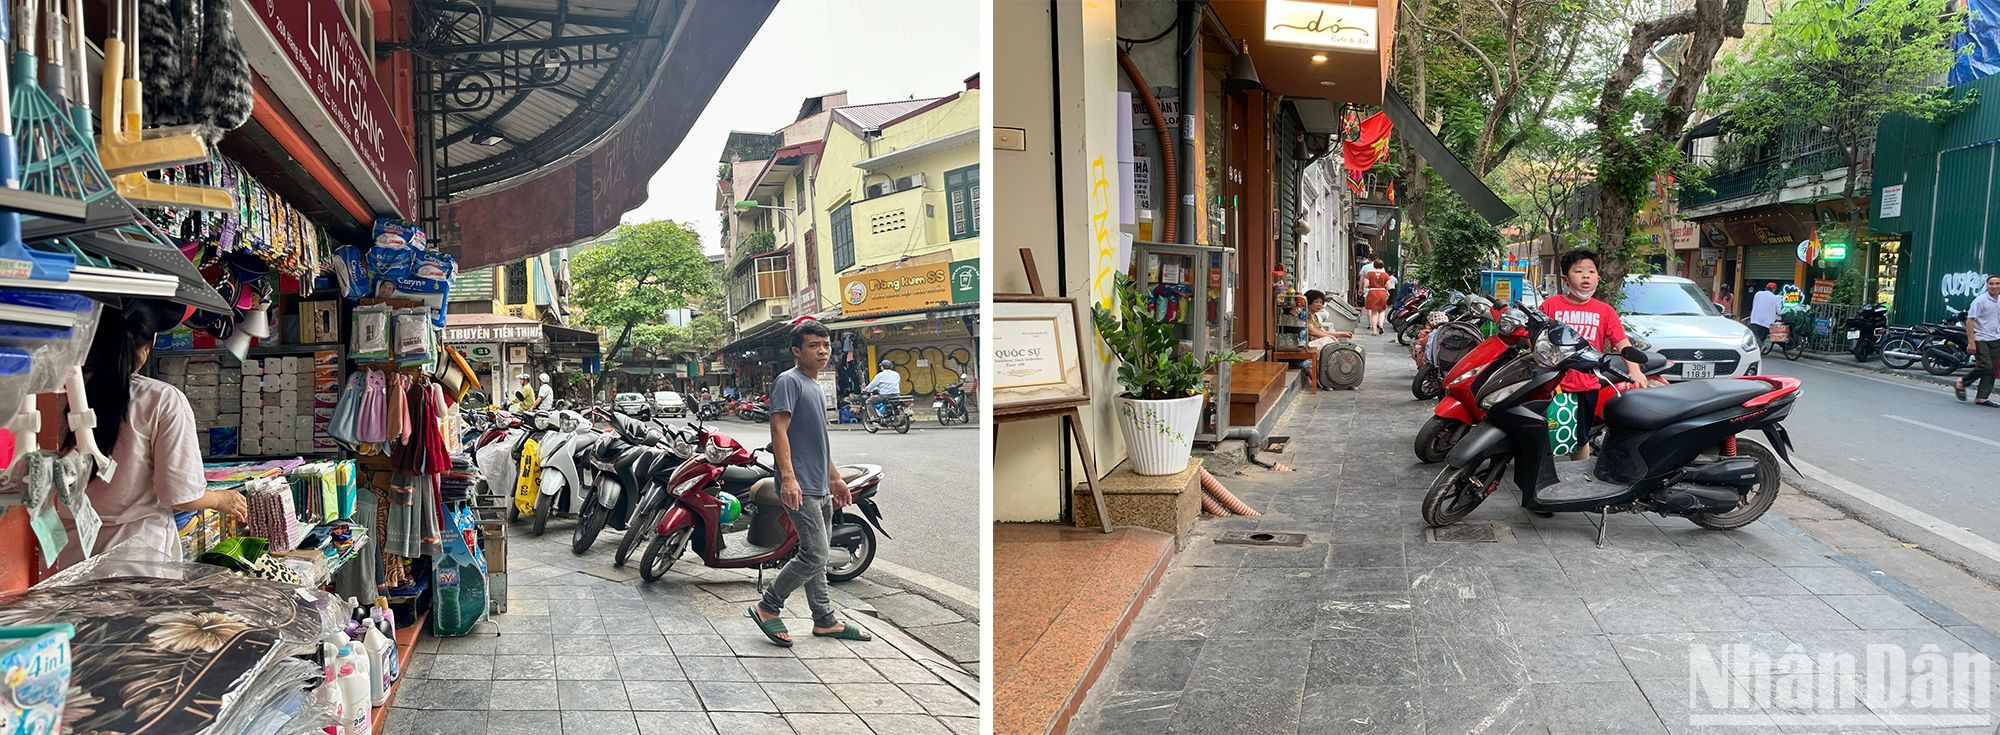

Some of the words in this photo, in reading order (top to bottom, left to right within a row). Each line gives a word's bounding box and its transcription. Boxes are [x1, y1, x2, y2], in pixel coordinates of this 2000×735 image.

[348, 45, 368, 93] PHẨM
[308, 1, 347, 104] LINH
[348, 79, 385, 163] GIANG
[397, 276, 422, 287] Caryn
[926, 270, 945, 284] SS
[1555, 310, 1600, 326] GAMING
[449, 325, 490, 340] TRUYỀN
[493, 324, 514, 339] TIẾN
